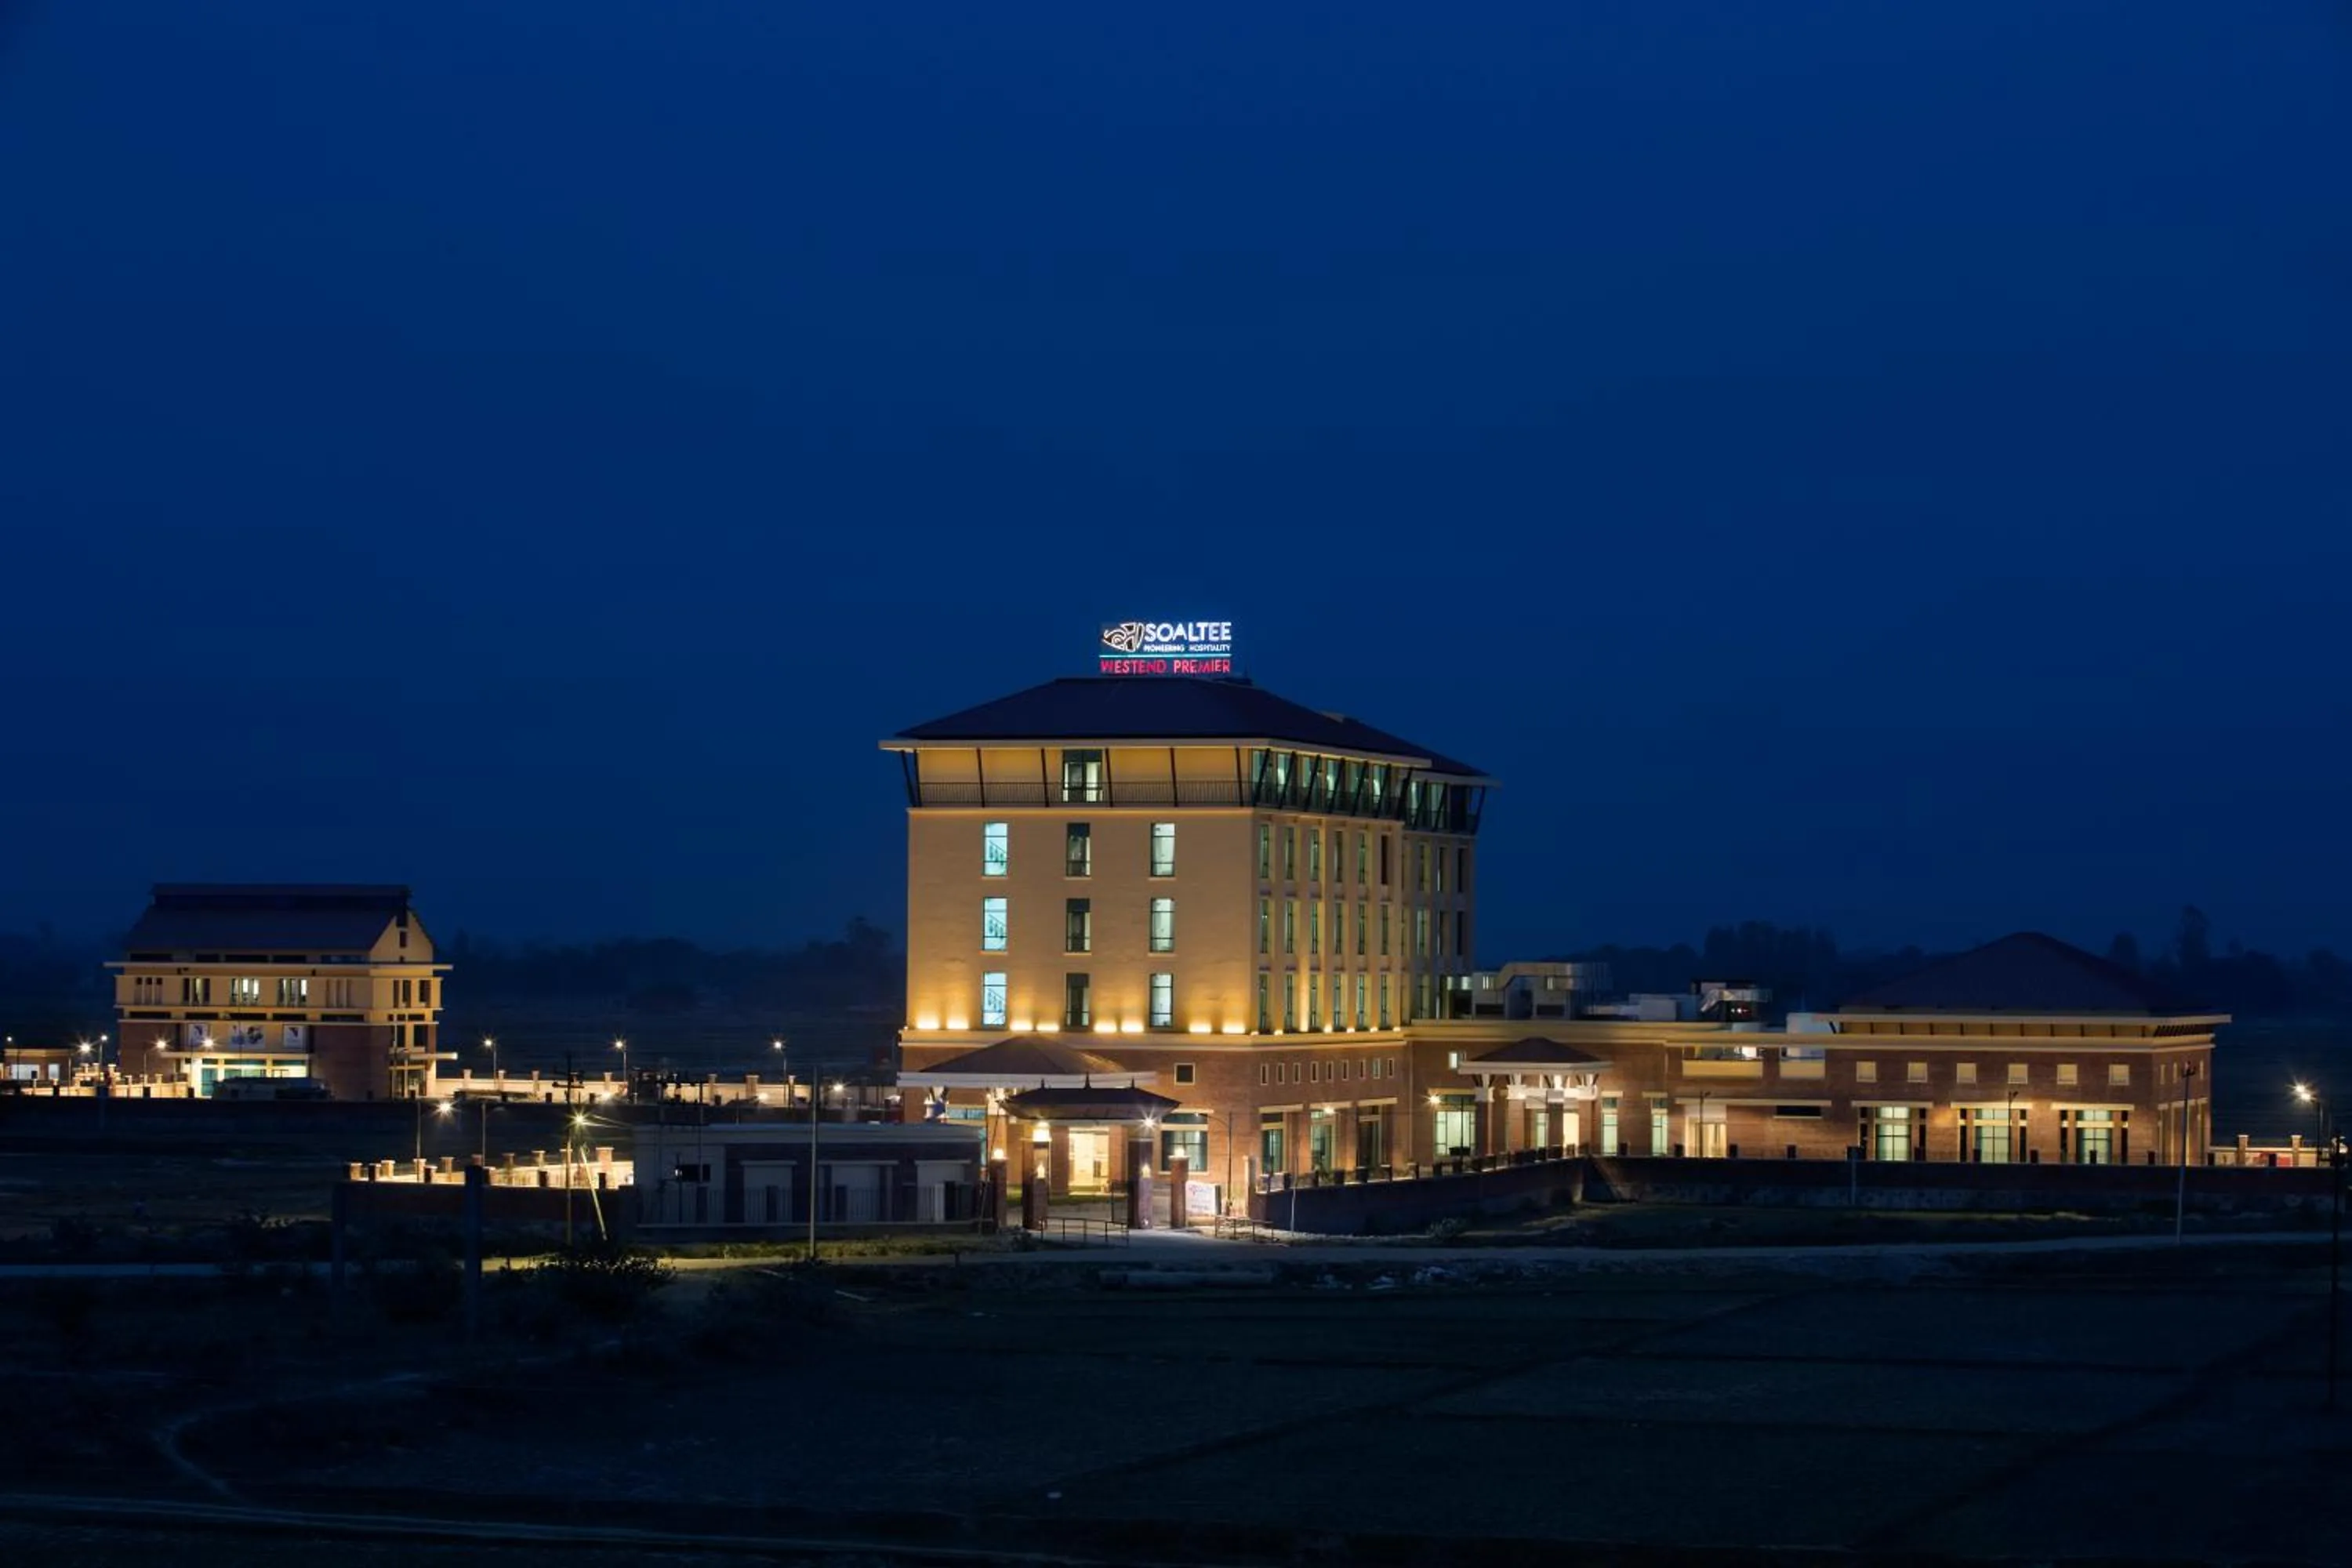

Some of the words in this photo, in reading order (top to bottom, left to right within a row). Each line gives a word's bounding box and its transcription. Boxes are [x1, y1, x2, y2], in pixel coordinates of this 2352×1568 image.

[1145, 622, 1232, 642] SOALTEE
[1101, 659, 1167, 674] WESTEND
[1174, 659, 1231, 673] PREMIER
